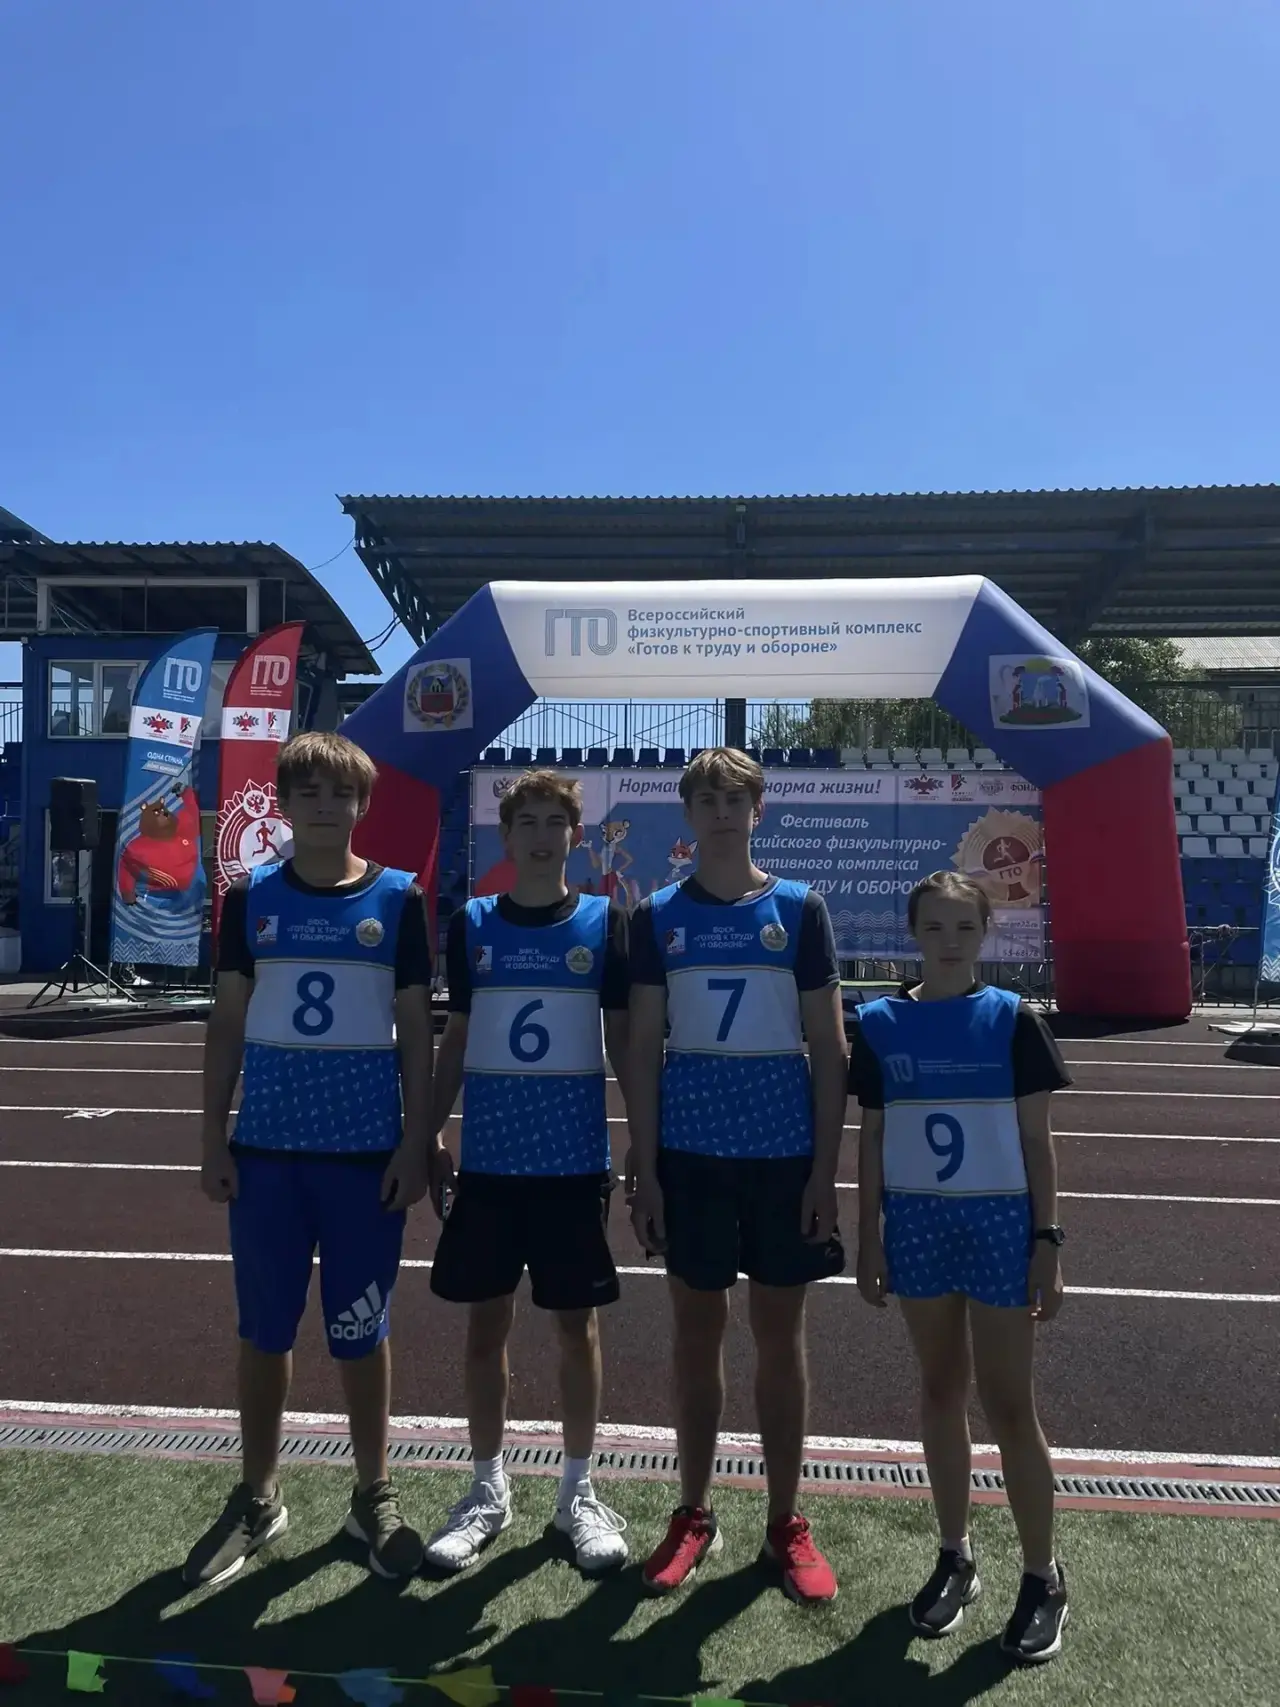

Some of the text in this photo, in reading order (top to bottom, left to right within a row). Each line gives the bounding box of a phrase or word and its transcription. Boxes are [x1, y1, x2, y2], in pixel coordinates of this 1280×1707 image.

[627, 607, 745, 624] Всероссийский
[544, 608, 618, 657] ГТО
[627, 621, 922, 641] физкультурно-спортивный комплекс
[627, 639, 838, 657] «Готов к труду и обороне»
[163, 656, 203, 692] ГТО
[251, 655, 291, 686] ГТО
[763, 782, 816, 797] норма
[819, 778, 882, 795] жизни!
[780, 813, 870, 829] Фестиваль
[826, 835, 947, 853] физкультурно-
[837, 857, 920, 871] комплекса
[999, 866, 1023, 880] ГТО
[840, 880, 853, 894] И
[292, 971, 335, 1037] 8
[707, 978, 748, 1042] 7
[508, 998, 550, 1063] 6
[925, 1112, 965, 1183] 9
